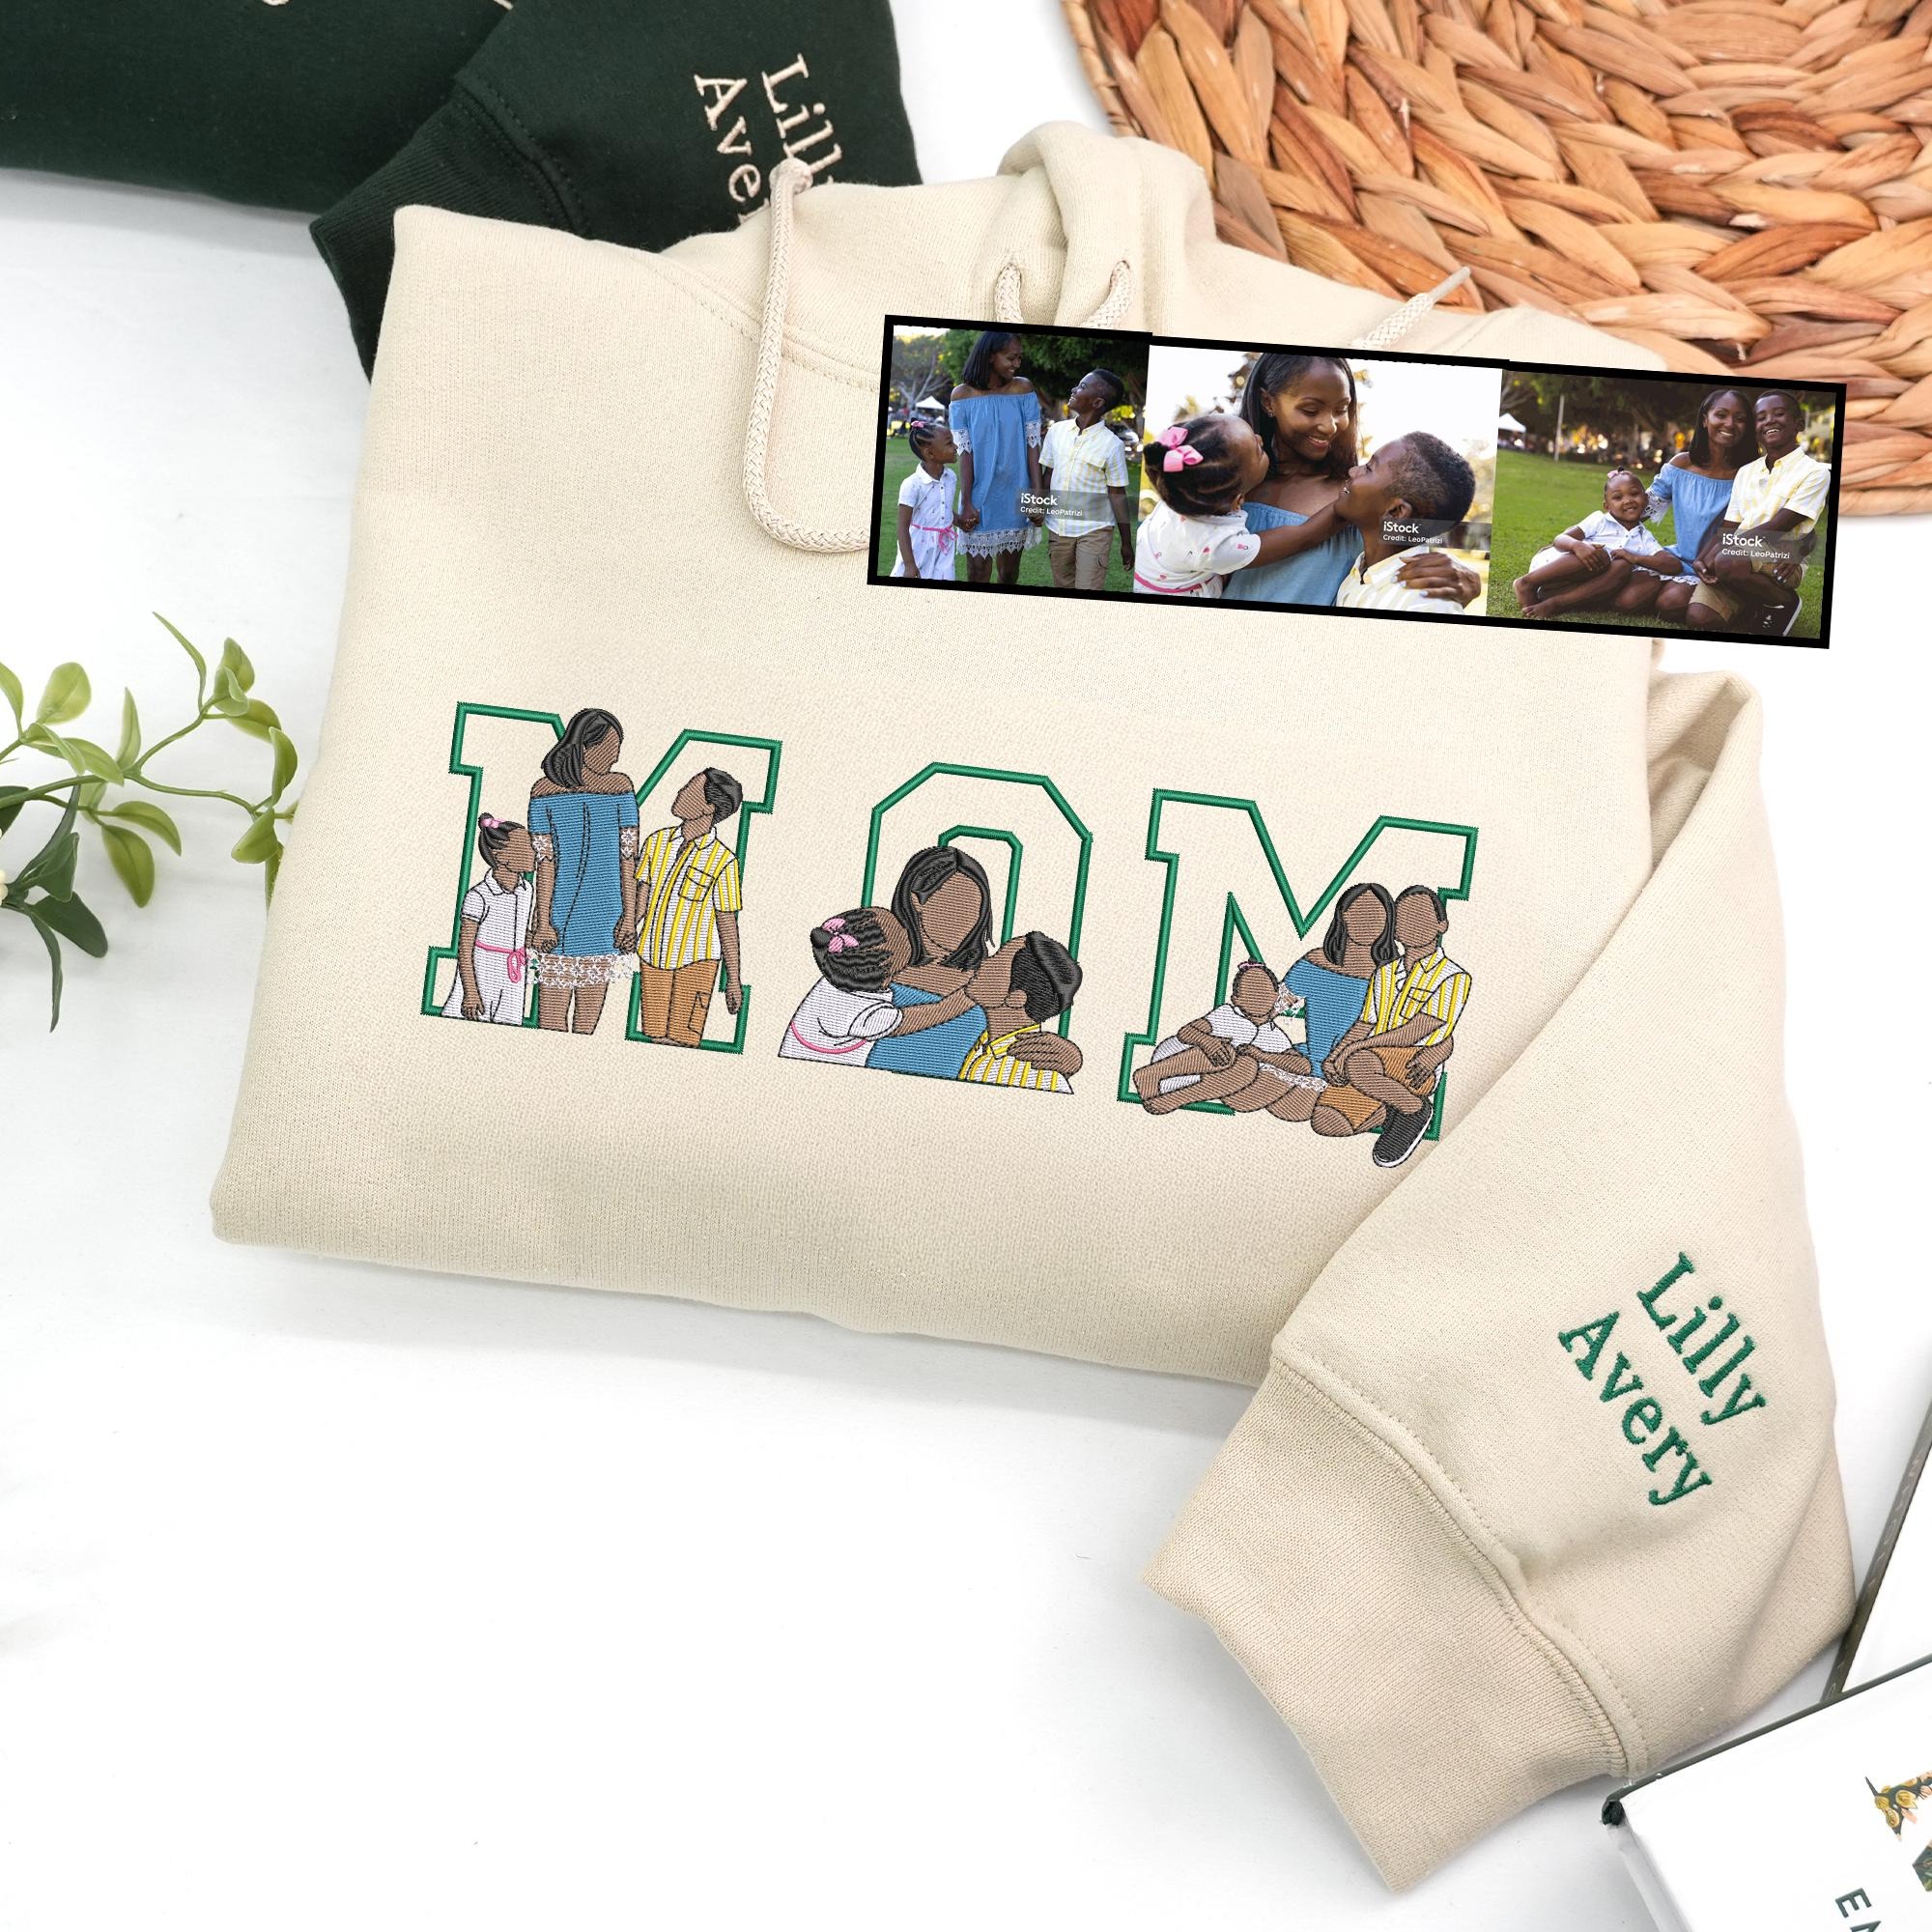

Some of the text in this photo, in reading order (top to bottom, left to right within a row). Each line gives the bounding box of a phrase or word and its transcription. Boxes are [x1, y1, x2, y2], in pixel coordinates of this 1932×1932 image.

[761, 52, 842, 185] Lill
[420, 700, 1480, 1142] MOM
[1556, 1310, 1714, 1507] Avery
[1635, 1250, 1767, 1426] Lilly
